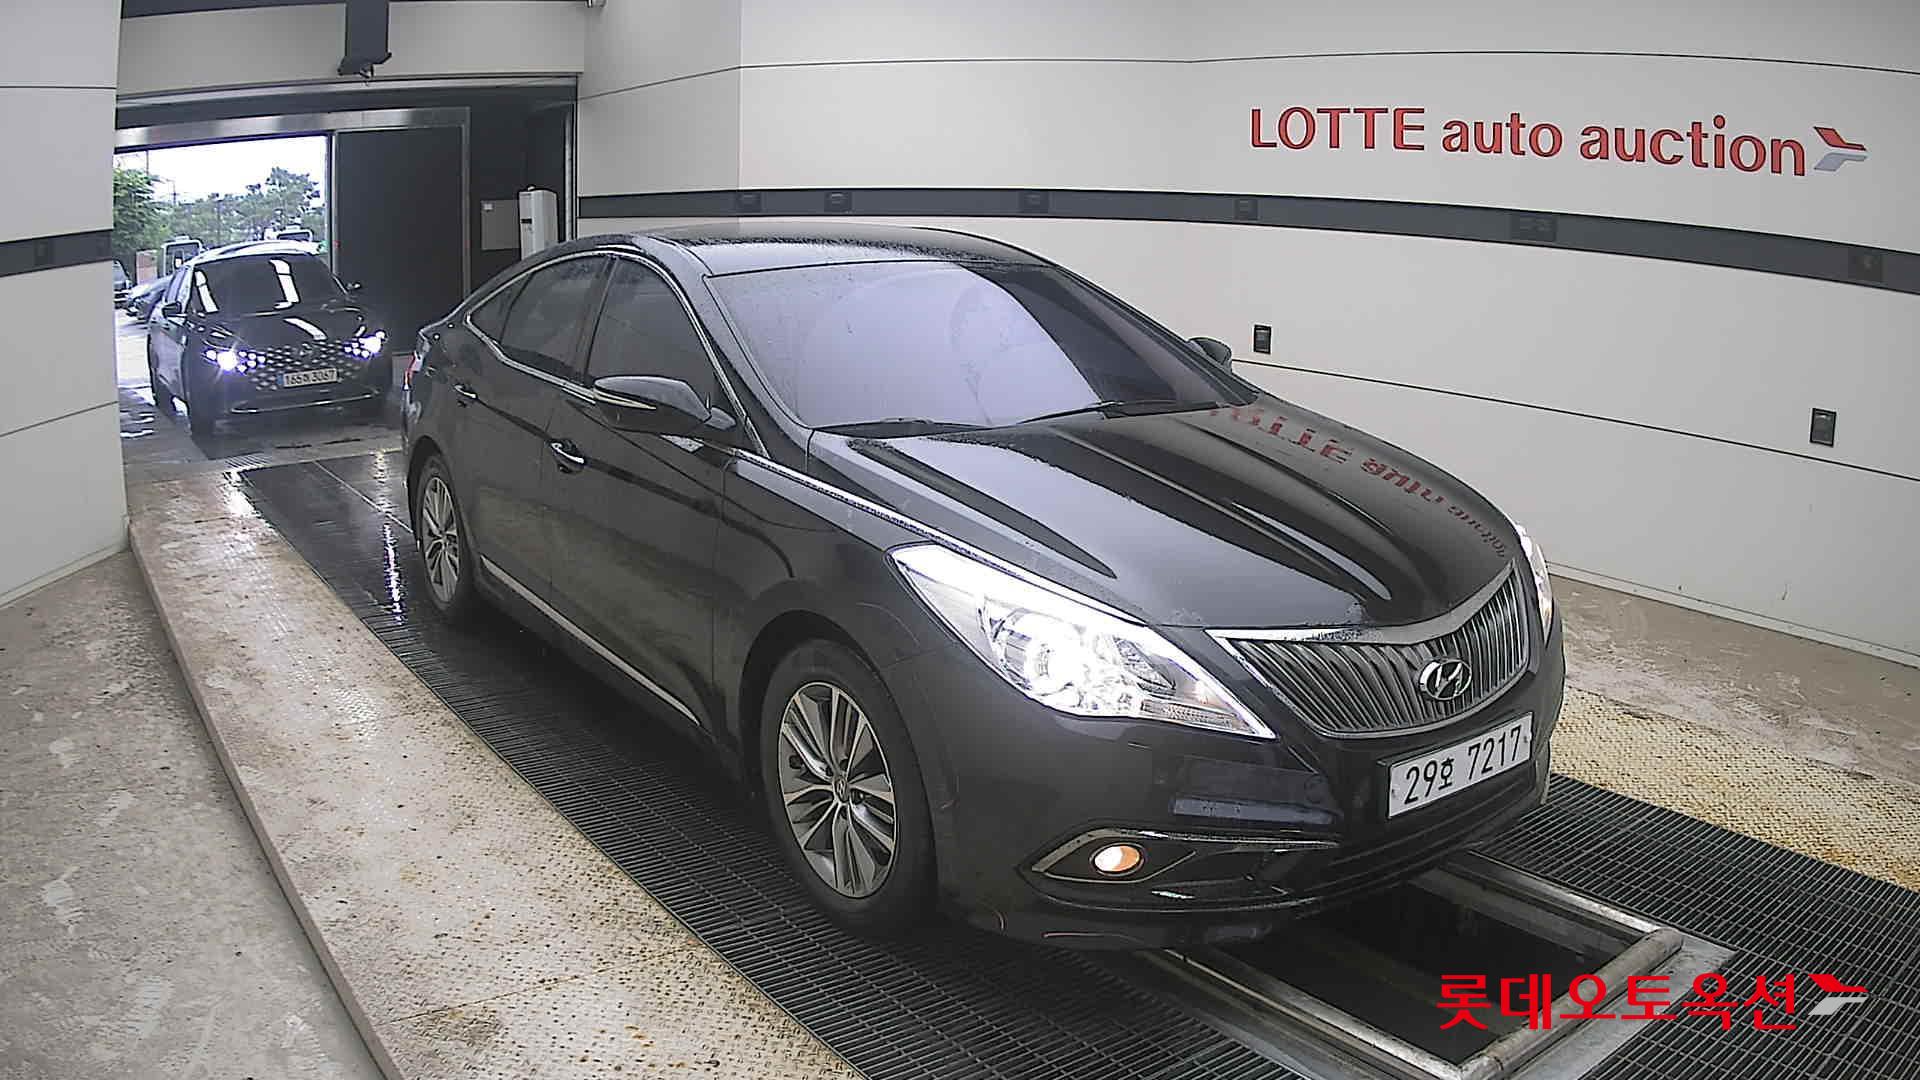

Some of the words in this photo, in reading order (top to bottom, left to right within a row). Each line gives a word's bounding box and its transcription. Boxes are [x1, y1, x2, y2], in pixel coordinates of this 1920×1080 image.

[1250, 107, 1426, 151] LOTTE
[1441, 112, 1563, 159] auto
[1579, 114, 1806, 177] auction
[1403, 757, 1455, 805] 29호
[1467, 725, 1522, 781] 7217
